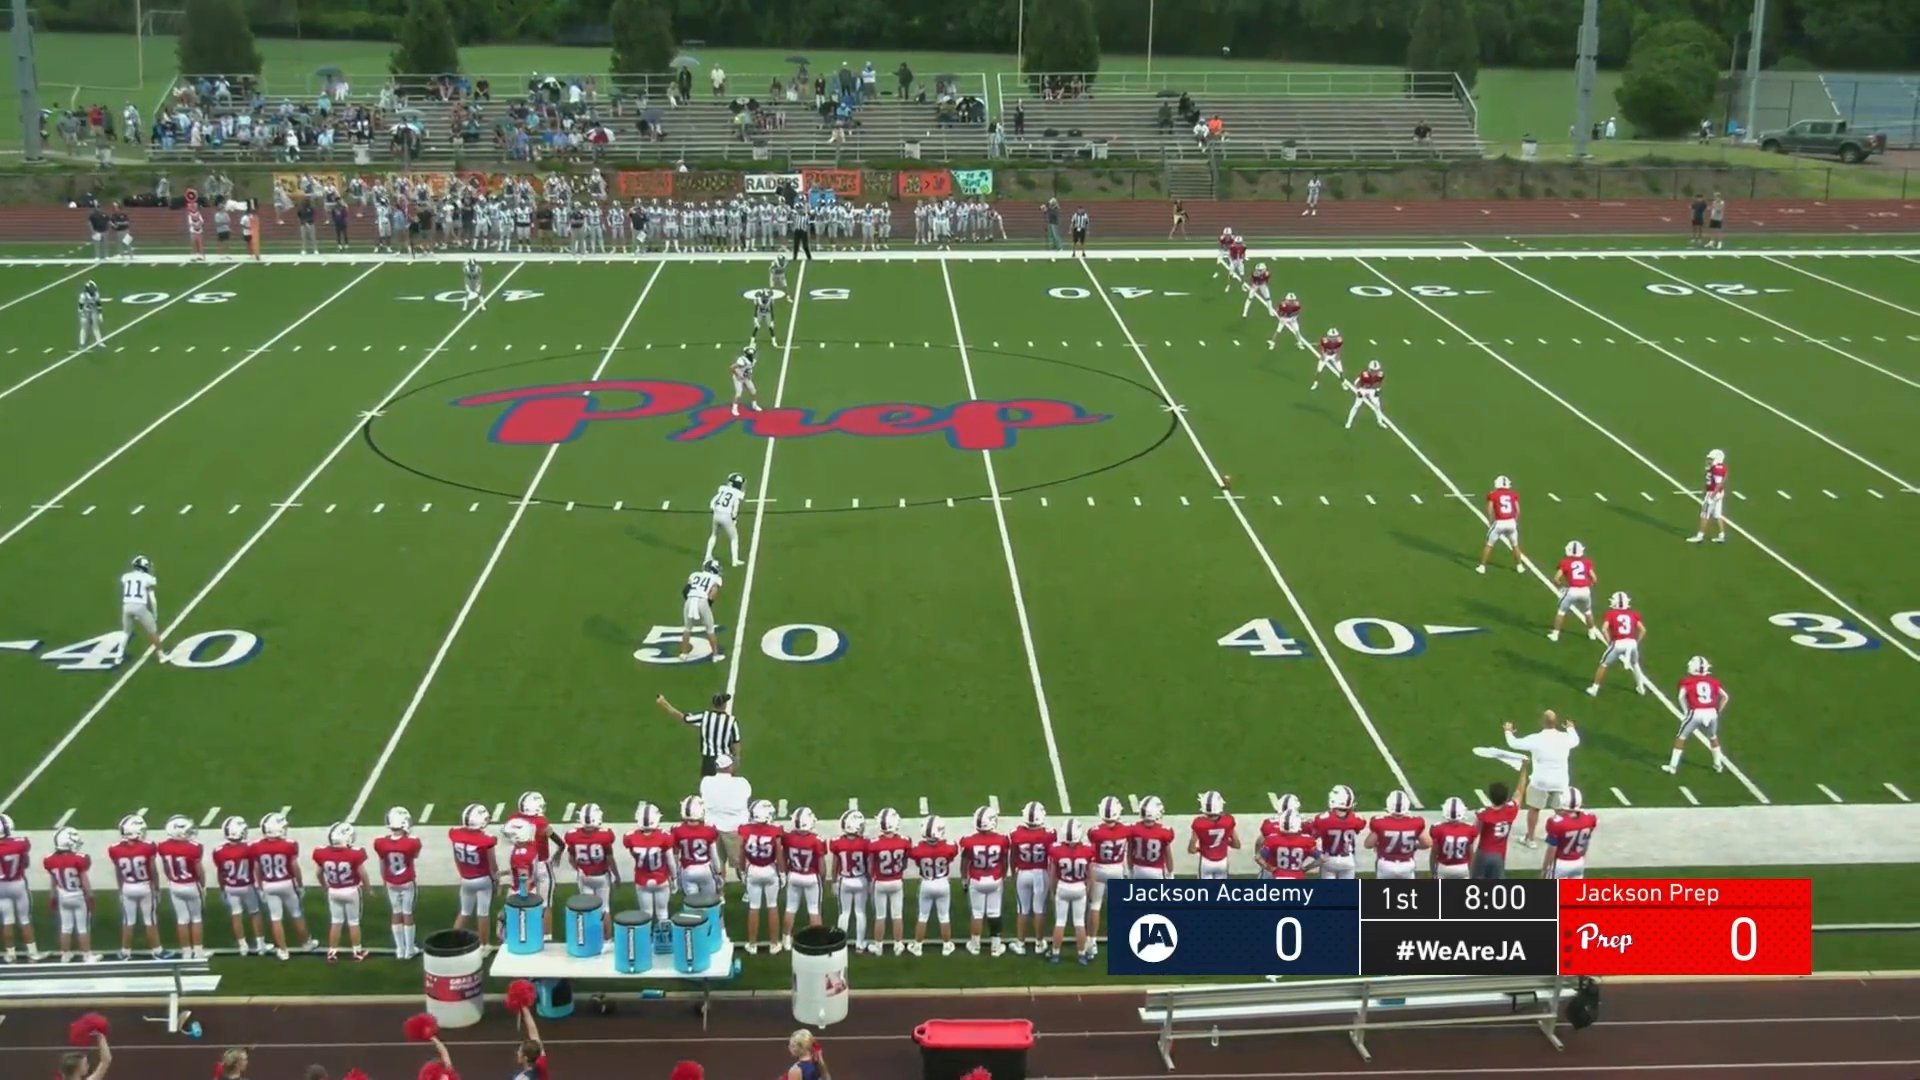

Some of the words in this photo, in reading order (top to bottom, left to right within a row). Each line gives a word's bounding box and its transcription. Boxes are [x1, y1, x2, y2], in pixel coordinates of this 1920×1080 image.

[449, 379, 1113, 451] Prep
[716, 491, 733, 508] 13
[1499, 494, 1513, 514] 5
[1570, 561, 1585, 580] 2
[124, 580, 143, 598] 11
[691, 575, 711, 592] 24
[1616, 614, 1632, 635] 3
[1695, 681, 1712, 704] 9
[680, 838, 708, 861] 12
[744, 834, 773, 858] 45
[1134, 837, 1162, 862] 18
[1207, 828, 1225, 849] 7
[1384, 830, 1416, 853] 75
[453, 842, 479, 866] 55
[632, 847, 662, 872] 70
[789, 847, 813, 872] 57
[838, 850, 866, 876] 13
[879, 849, 904, 874] 23
[972, 844, 1001, 868] 52
[1276, 846, 1304, 870] 63
[223, 859, 250, 885] 24
[1059, 857, 1088, 881] 20
